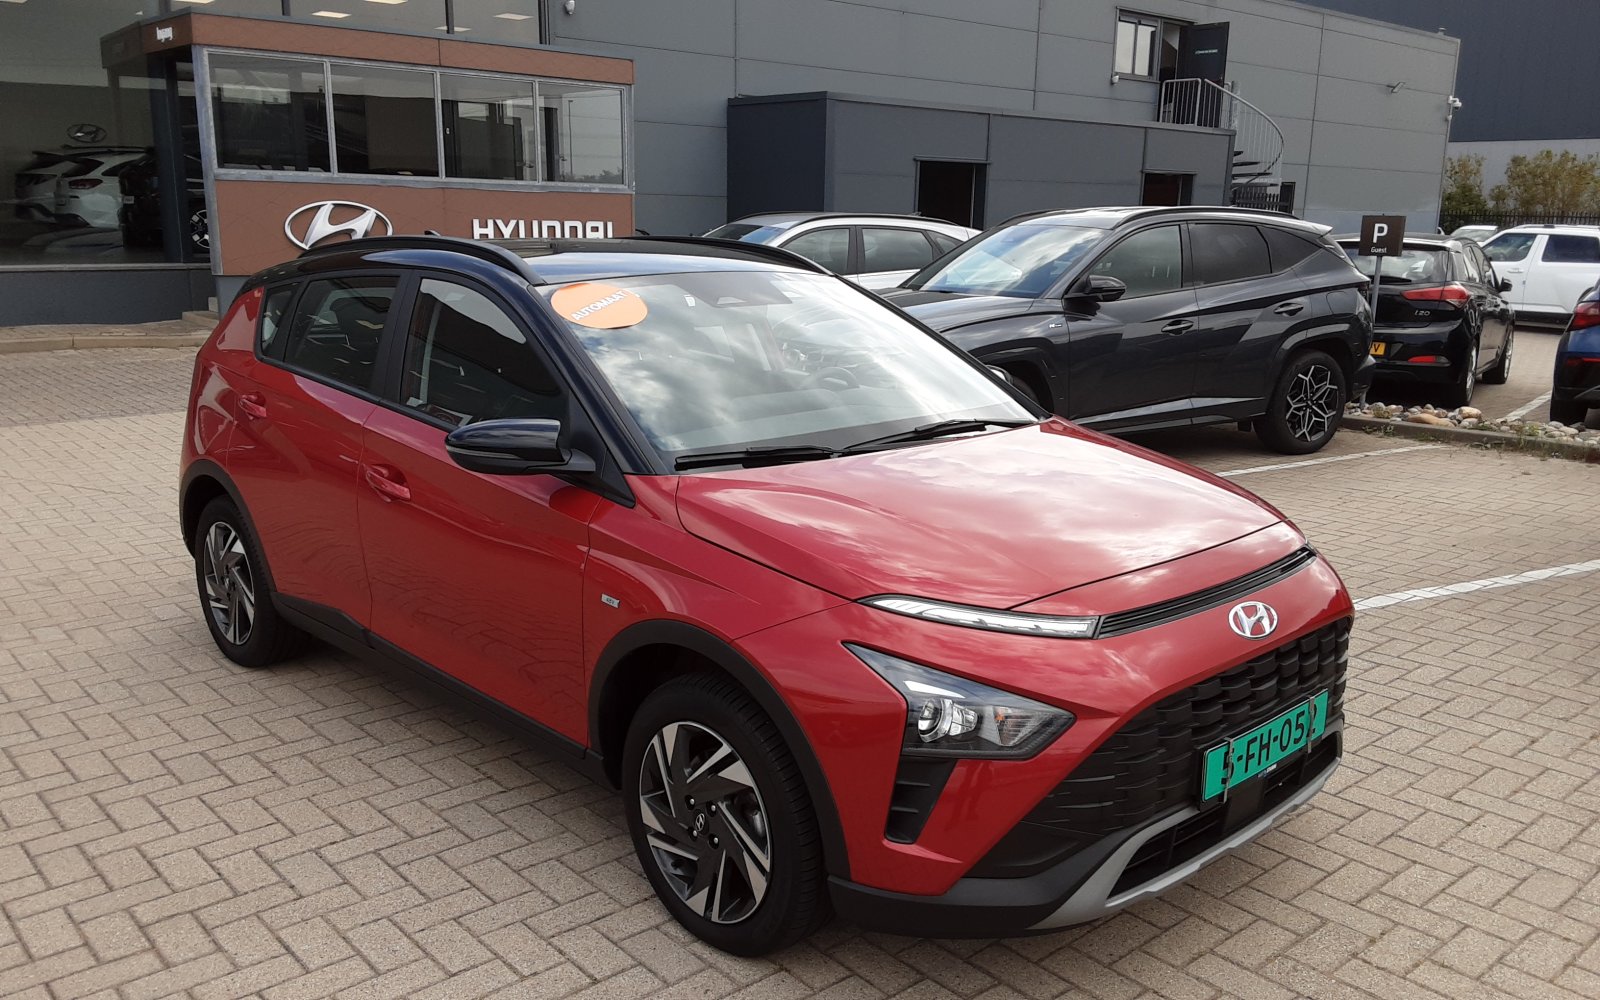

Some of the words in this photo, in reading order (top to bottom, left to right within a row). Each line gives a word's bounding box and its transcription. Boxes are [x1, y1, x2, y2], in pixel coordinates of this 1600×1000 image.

[472, 218, 613, 239] HYUNDAI
[1372, 223, 1388, 243] P
[571, 290, 628, 320] AUTOMAAT
